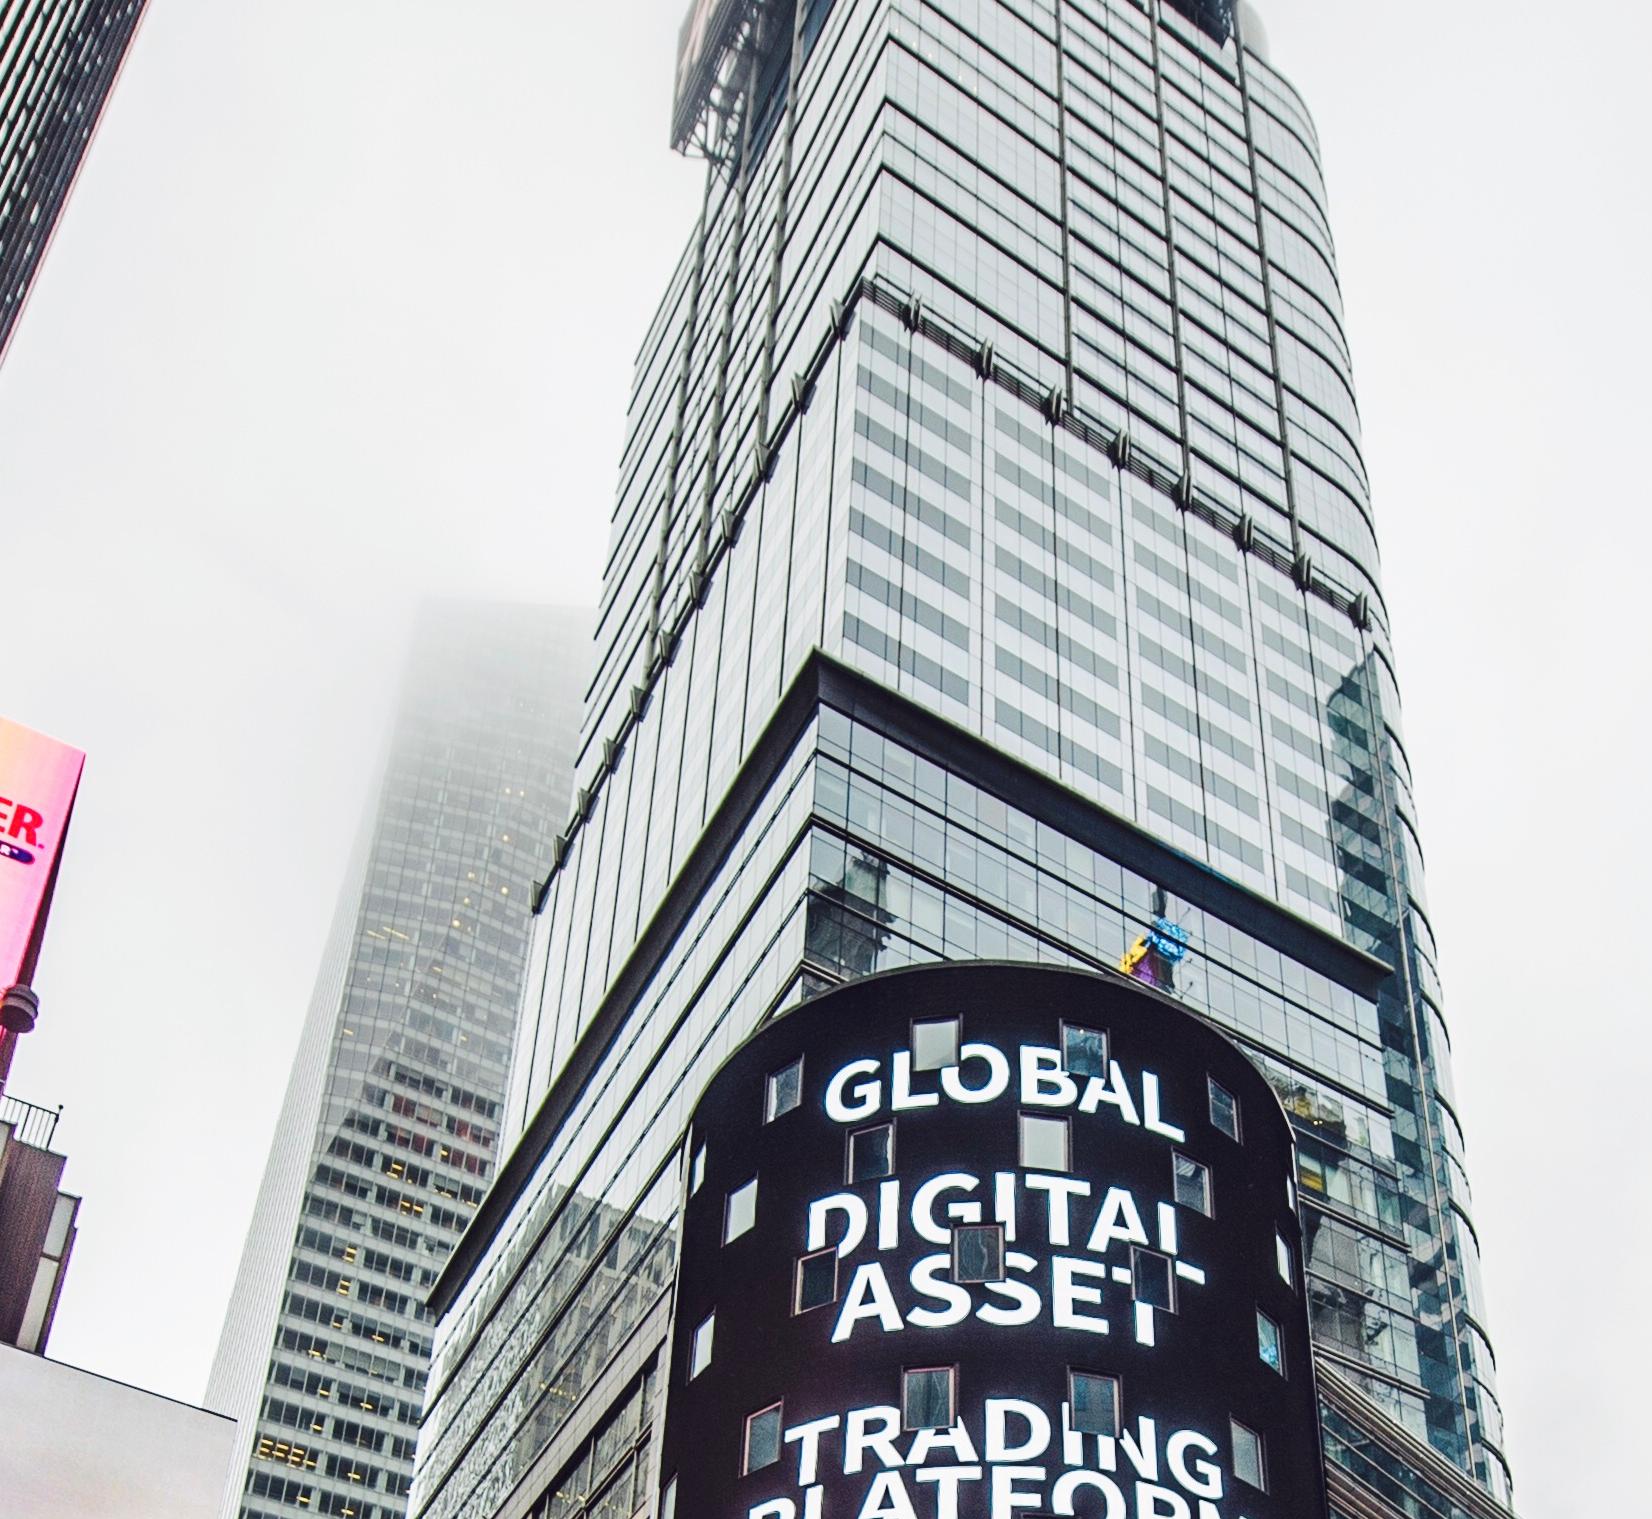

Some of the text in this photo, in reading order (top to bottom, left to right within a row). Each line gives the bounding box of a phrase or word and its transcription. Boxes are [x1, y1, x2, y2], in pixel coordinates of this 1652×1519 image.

[824, 1042, 1187, 1143] GLOBAL
[807, 1171, 1205, 1285] DIGITAL
[785, 1398, 1222, 1499] TRADING
